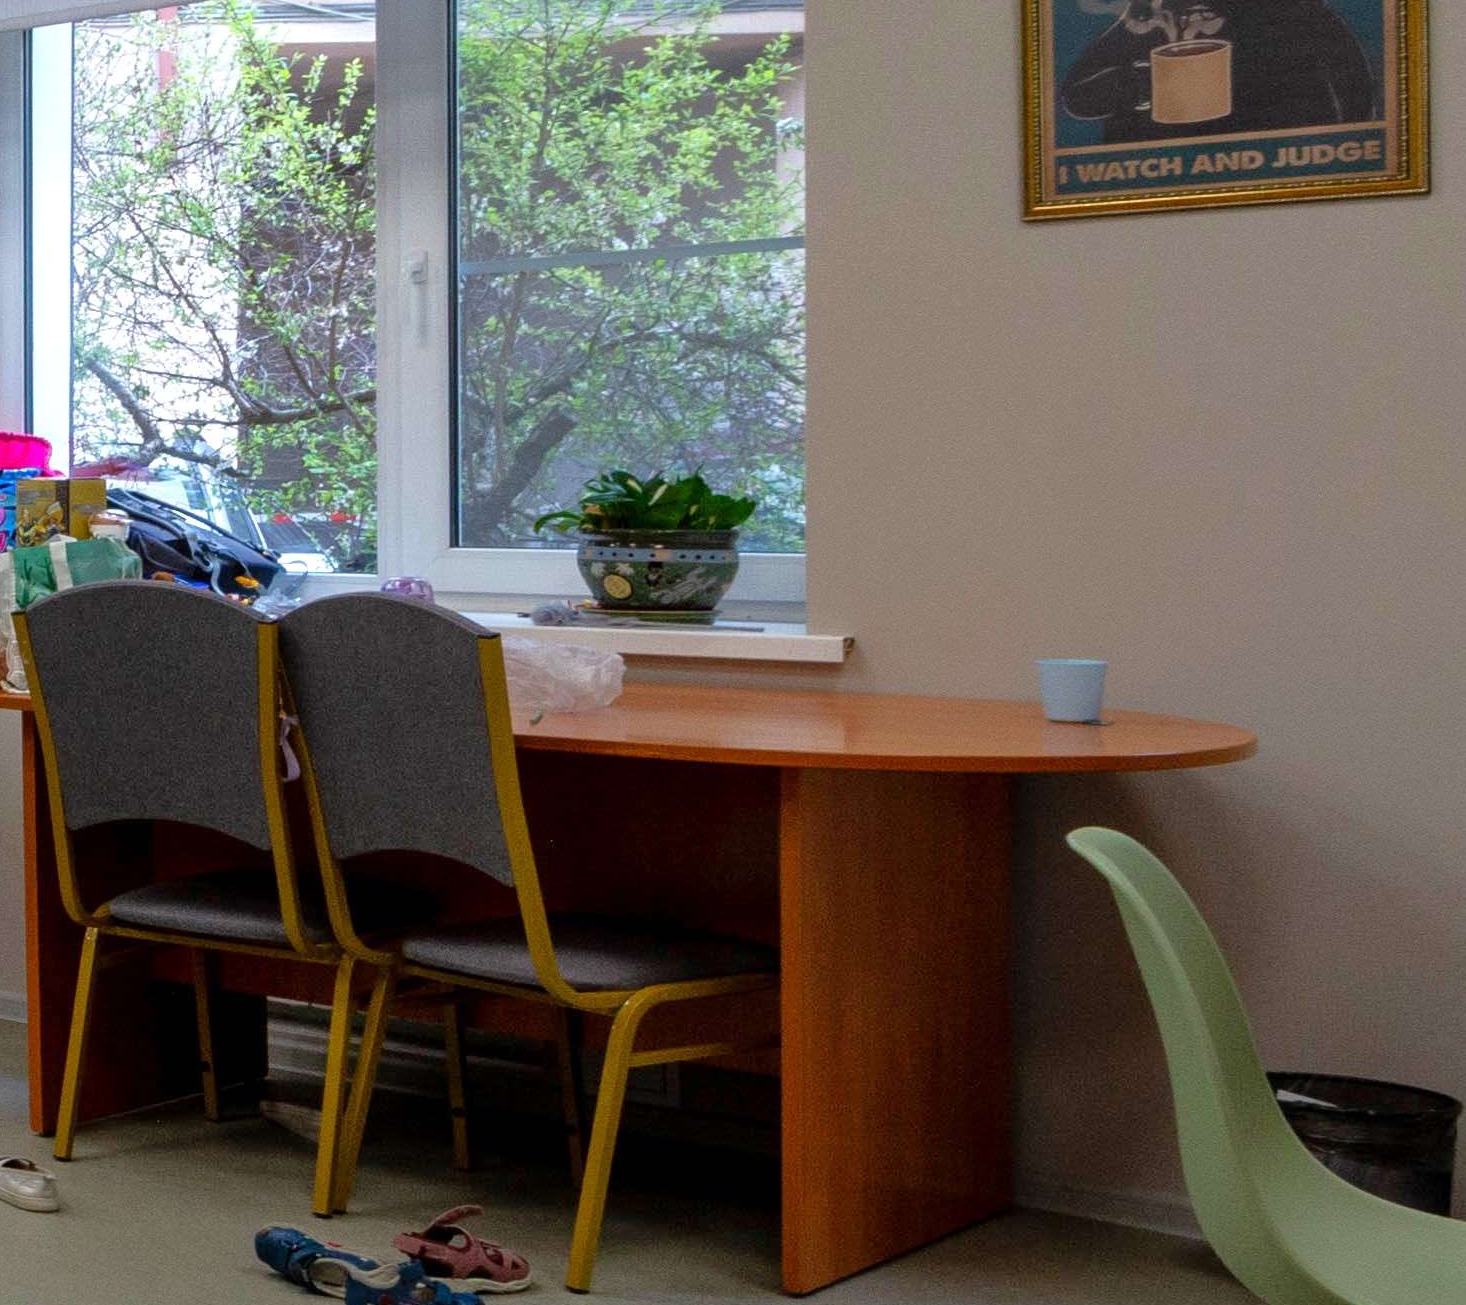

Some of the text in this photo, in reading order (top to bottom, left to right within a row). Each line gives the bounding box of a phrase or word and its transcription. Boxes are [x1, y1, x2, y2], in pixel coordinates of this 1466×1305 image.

[1059, 139, 1381, 185] I WATCH AND JUDGE
